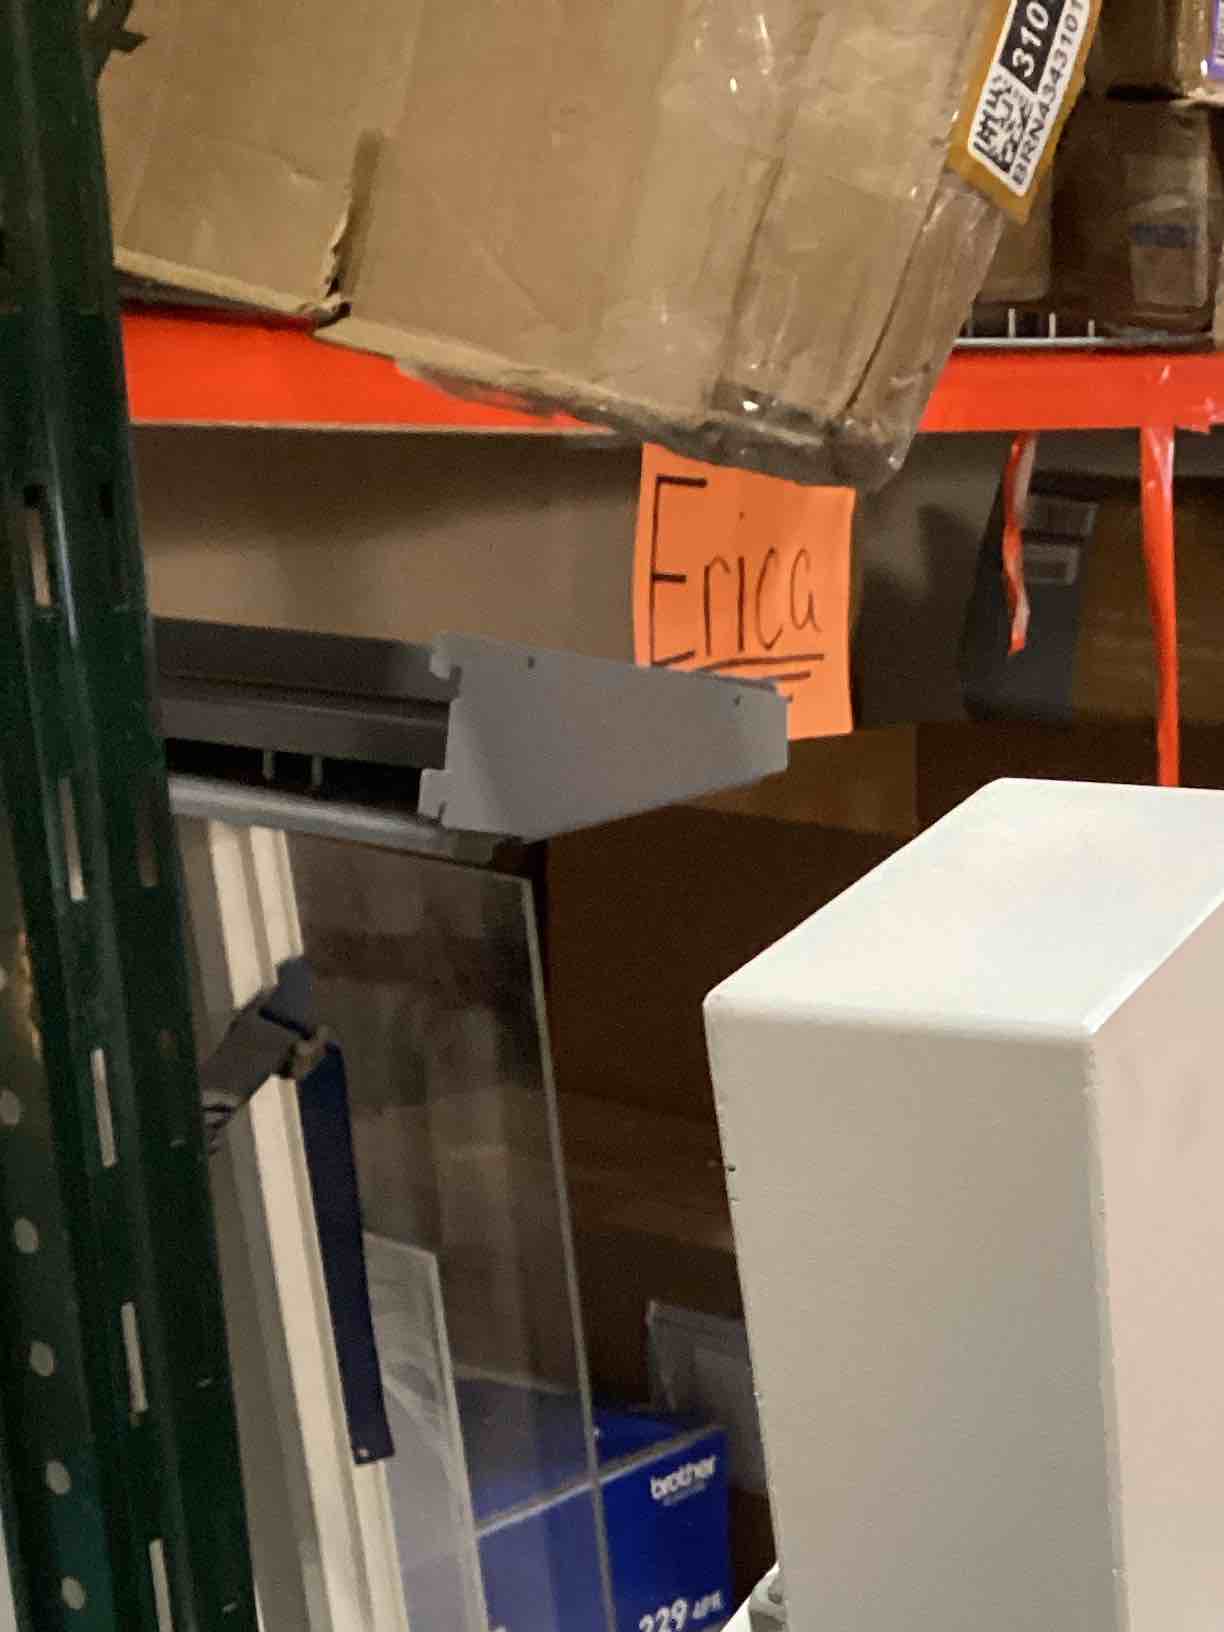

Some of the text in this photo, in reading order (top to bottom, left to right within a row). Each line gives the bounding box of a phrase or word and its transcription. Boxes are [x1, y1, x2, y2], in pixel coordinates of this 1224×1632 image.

[1012, 1, 1049, 78] 310
[649, 474, 822, 666] Erica
[651, 1455, 716, 1500] brother
